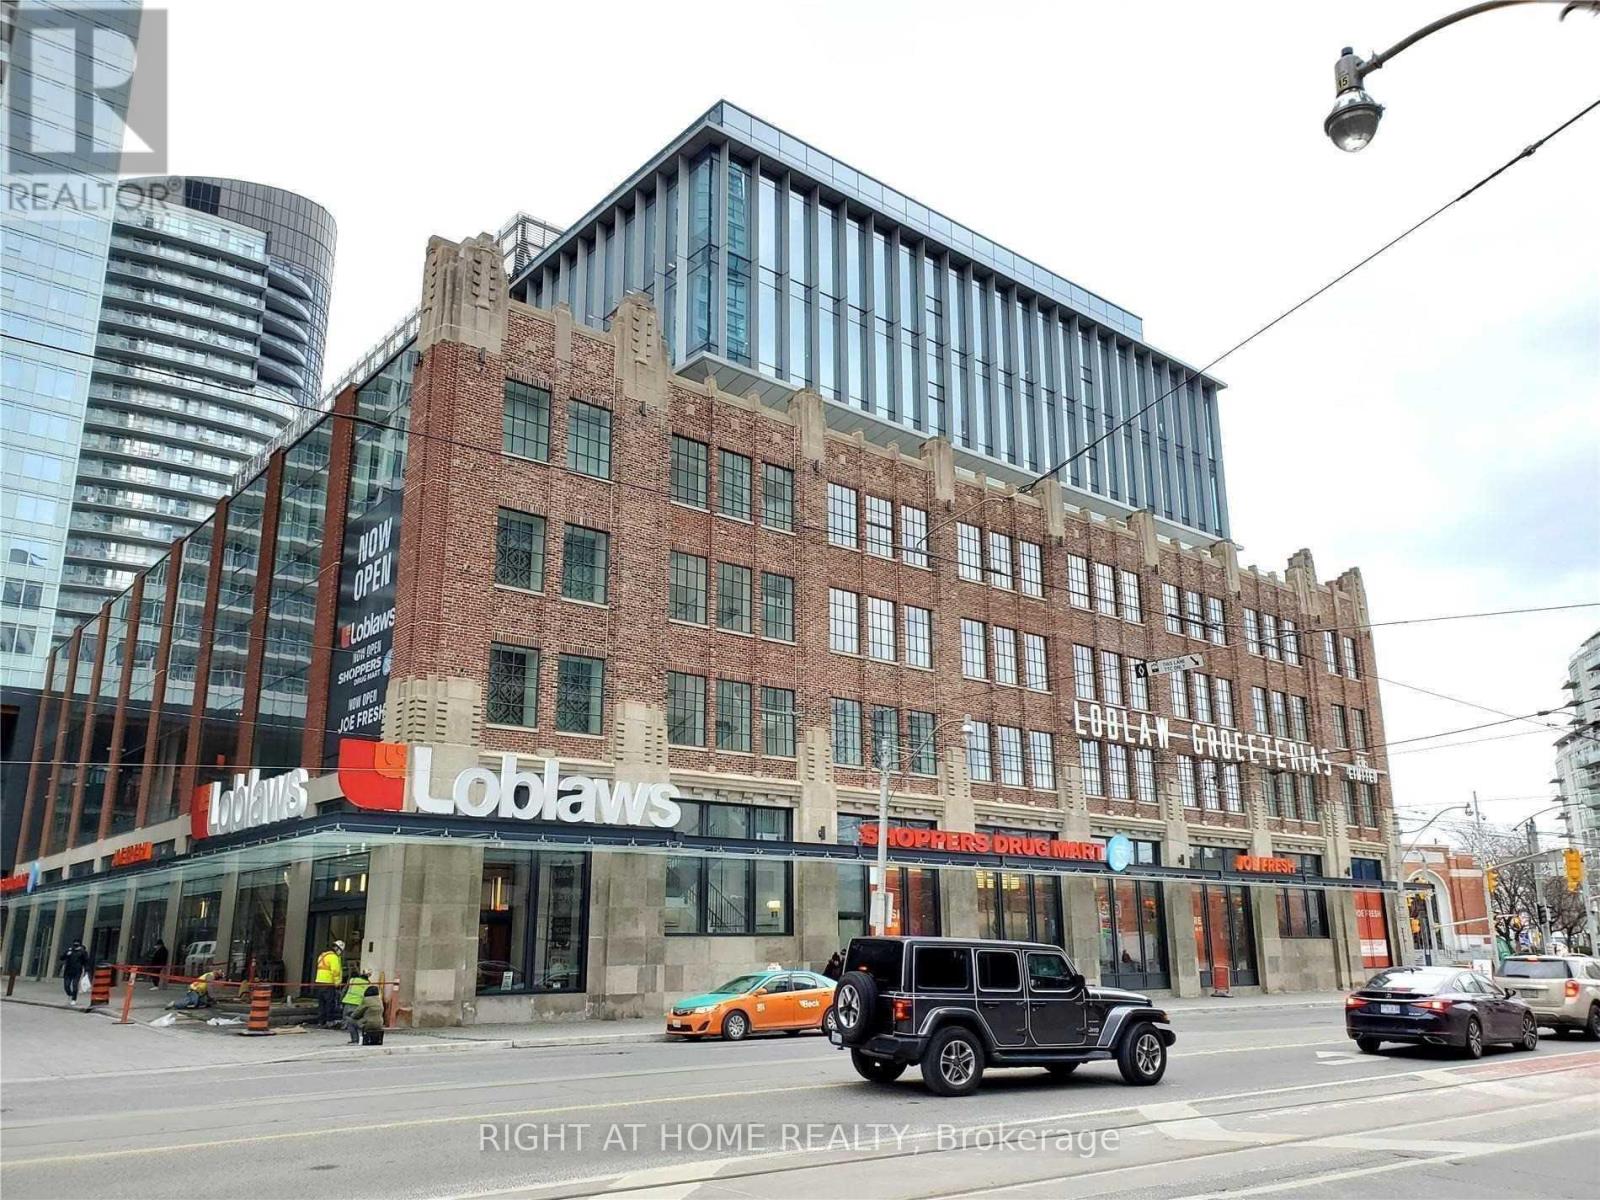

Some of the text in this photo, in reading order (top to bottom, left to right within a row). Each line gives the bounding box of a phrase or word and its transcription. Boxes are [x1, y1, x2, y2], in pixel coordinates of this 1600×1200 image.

[358, 517, 393, 565] NOW
[353, 552, 392, 601] OPEN
[350, 607, 395, 645] Loblaws
[366, 640, 382, 658] OPEN
[338, 656, 382, 685] SHOPPERS
[337, 714, 356, 734] JOE
[1073, 700, 1332, 776] LOBLAW GROCETERIAS
[207, 768, 308, 836] Loblaws
[414, 745, 682, 828] Loblaws
[859, 824, 1106, 861] SHOPPERS DRUG MART
[1261, 857, 1297, 874] FRESH
